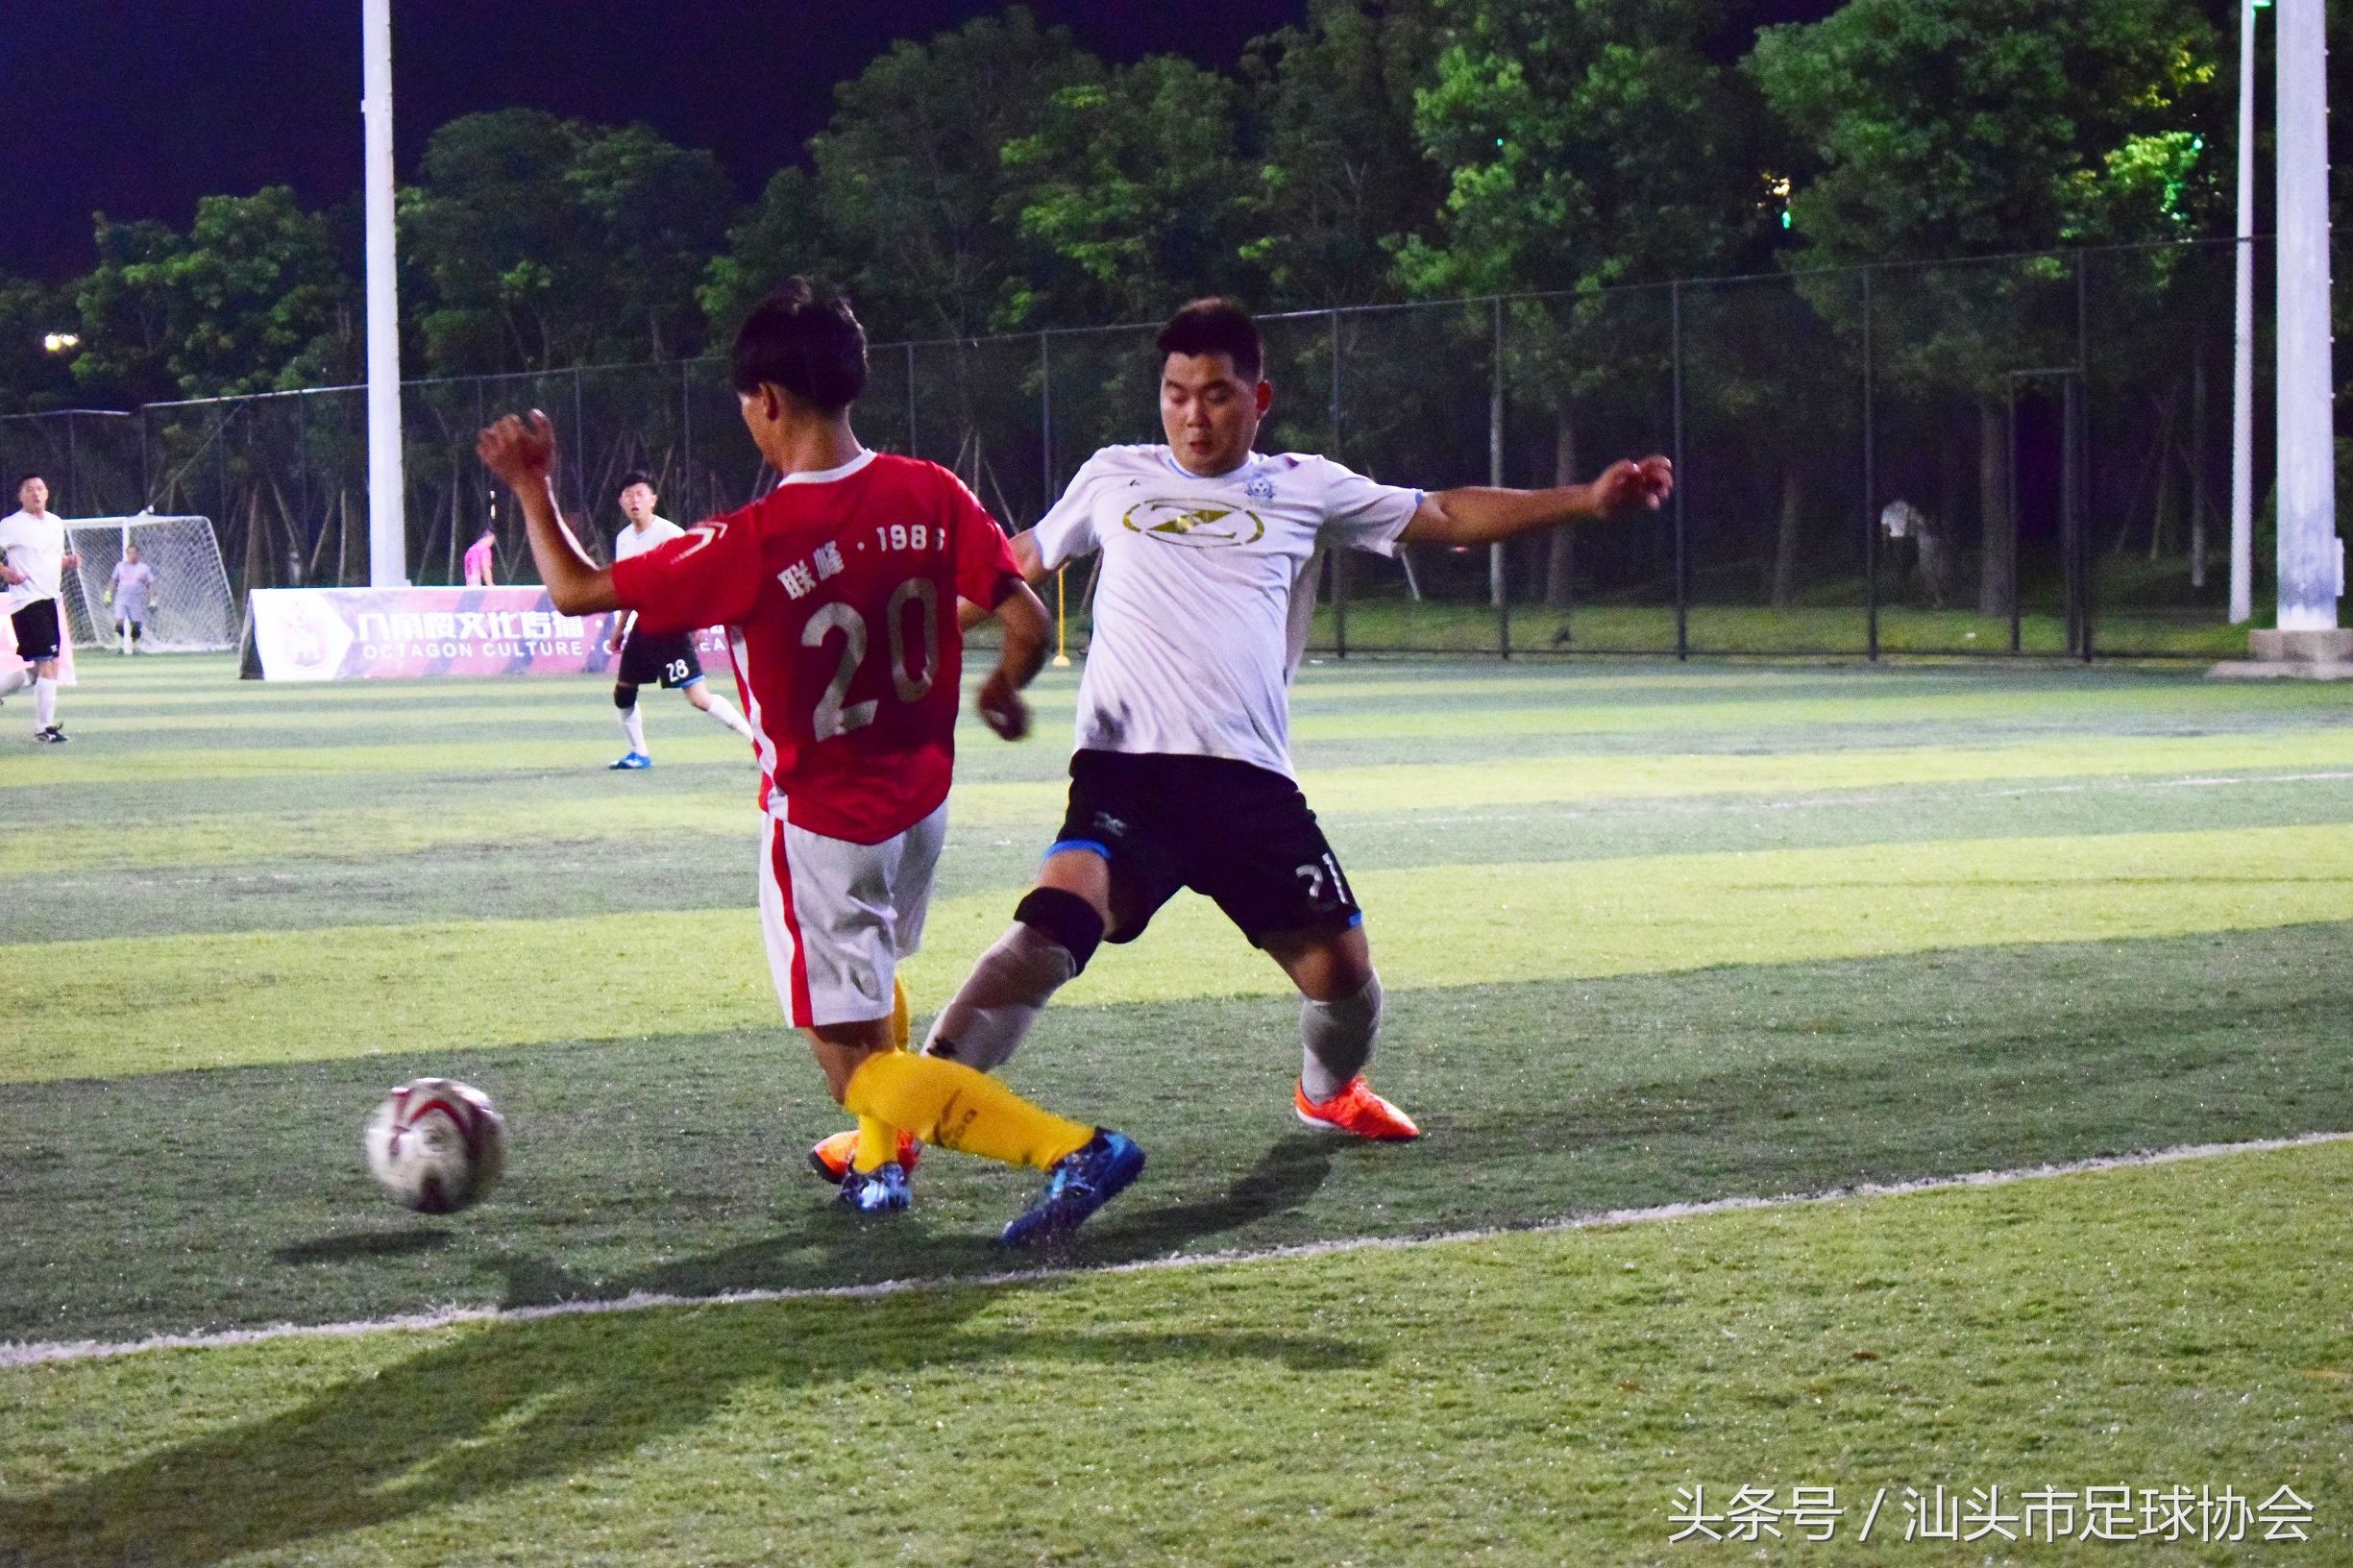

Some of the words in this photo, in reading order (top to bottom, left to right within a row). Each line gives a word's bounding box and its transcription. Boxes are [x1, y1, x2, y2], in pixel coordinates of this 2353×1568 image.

[364, 641, 474, 660] OCTAGON
[482, 641, 584, 657] CULTURE
[800, 576, 940, 744] 20
[665, 658, 690, 683] 28
